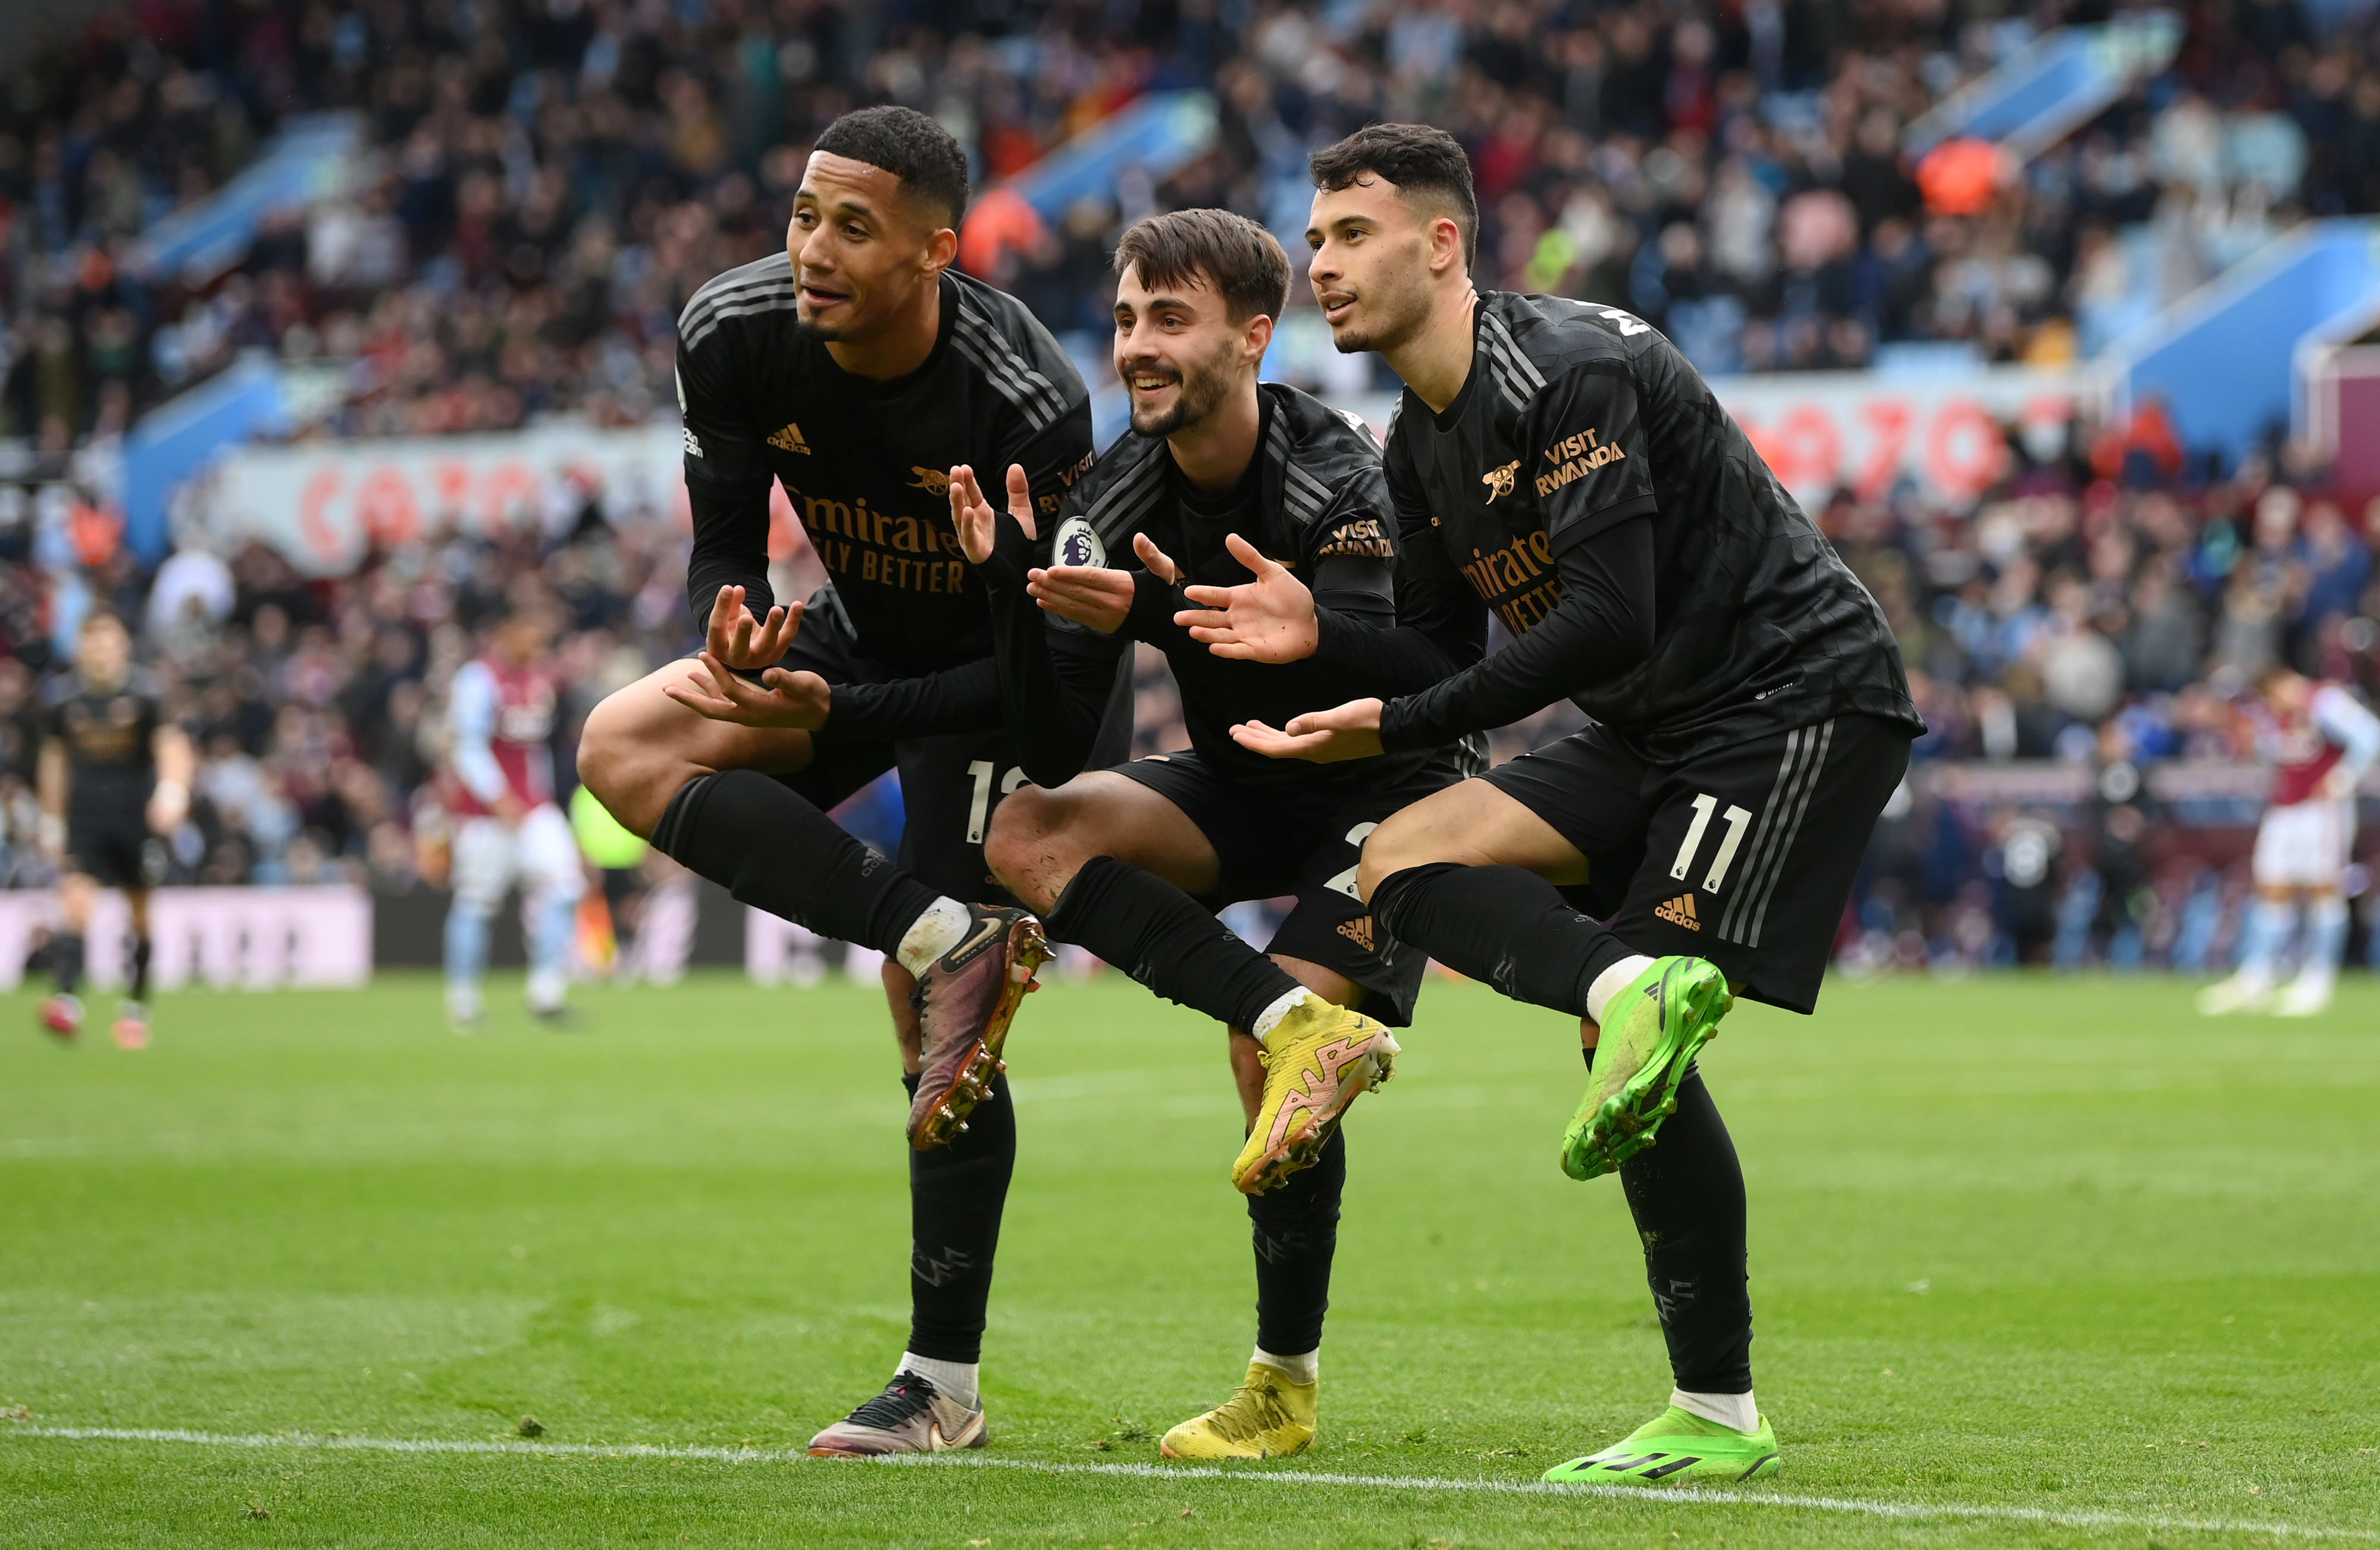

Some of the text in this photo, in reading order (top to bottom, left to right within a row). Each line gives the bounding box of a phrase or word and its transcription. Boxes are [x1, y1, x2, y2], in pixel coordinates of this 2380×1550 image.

[766, 436, 811, 455] adidas
[1544, 428, 1598, 465] VISIT
[1057, 450, 1094, 486] VISIT
[1535, 441, 1626, 497] RWANDA
[784, 484, 967, 560] mirate
[1332, 519, 1380, 541] VISIT
[862, 550, 964, 594] BETTER
[966, 760, 1033, 844] 1
[1670, 793, 1752, 894] 11
[1654, 906, 1701, 932] adidas
[1336, 925, 1374, 952] adidas
